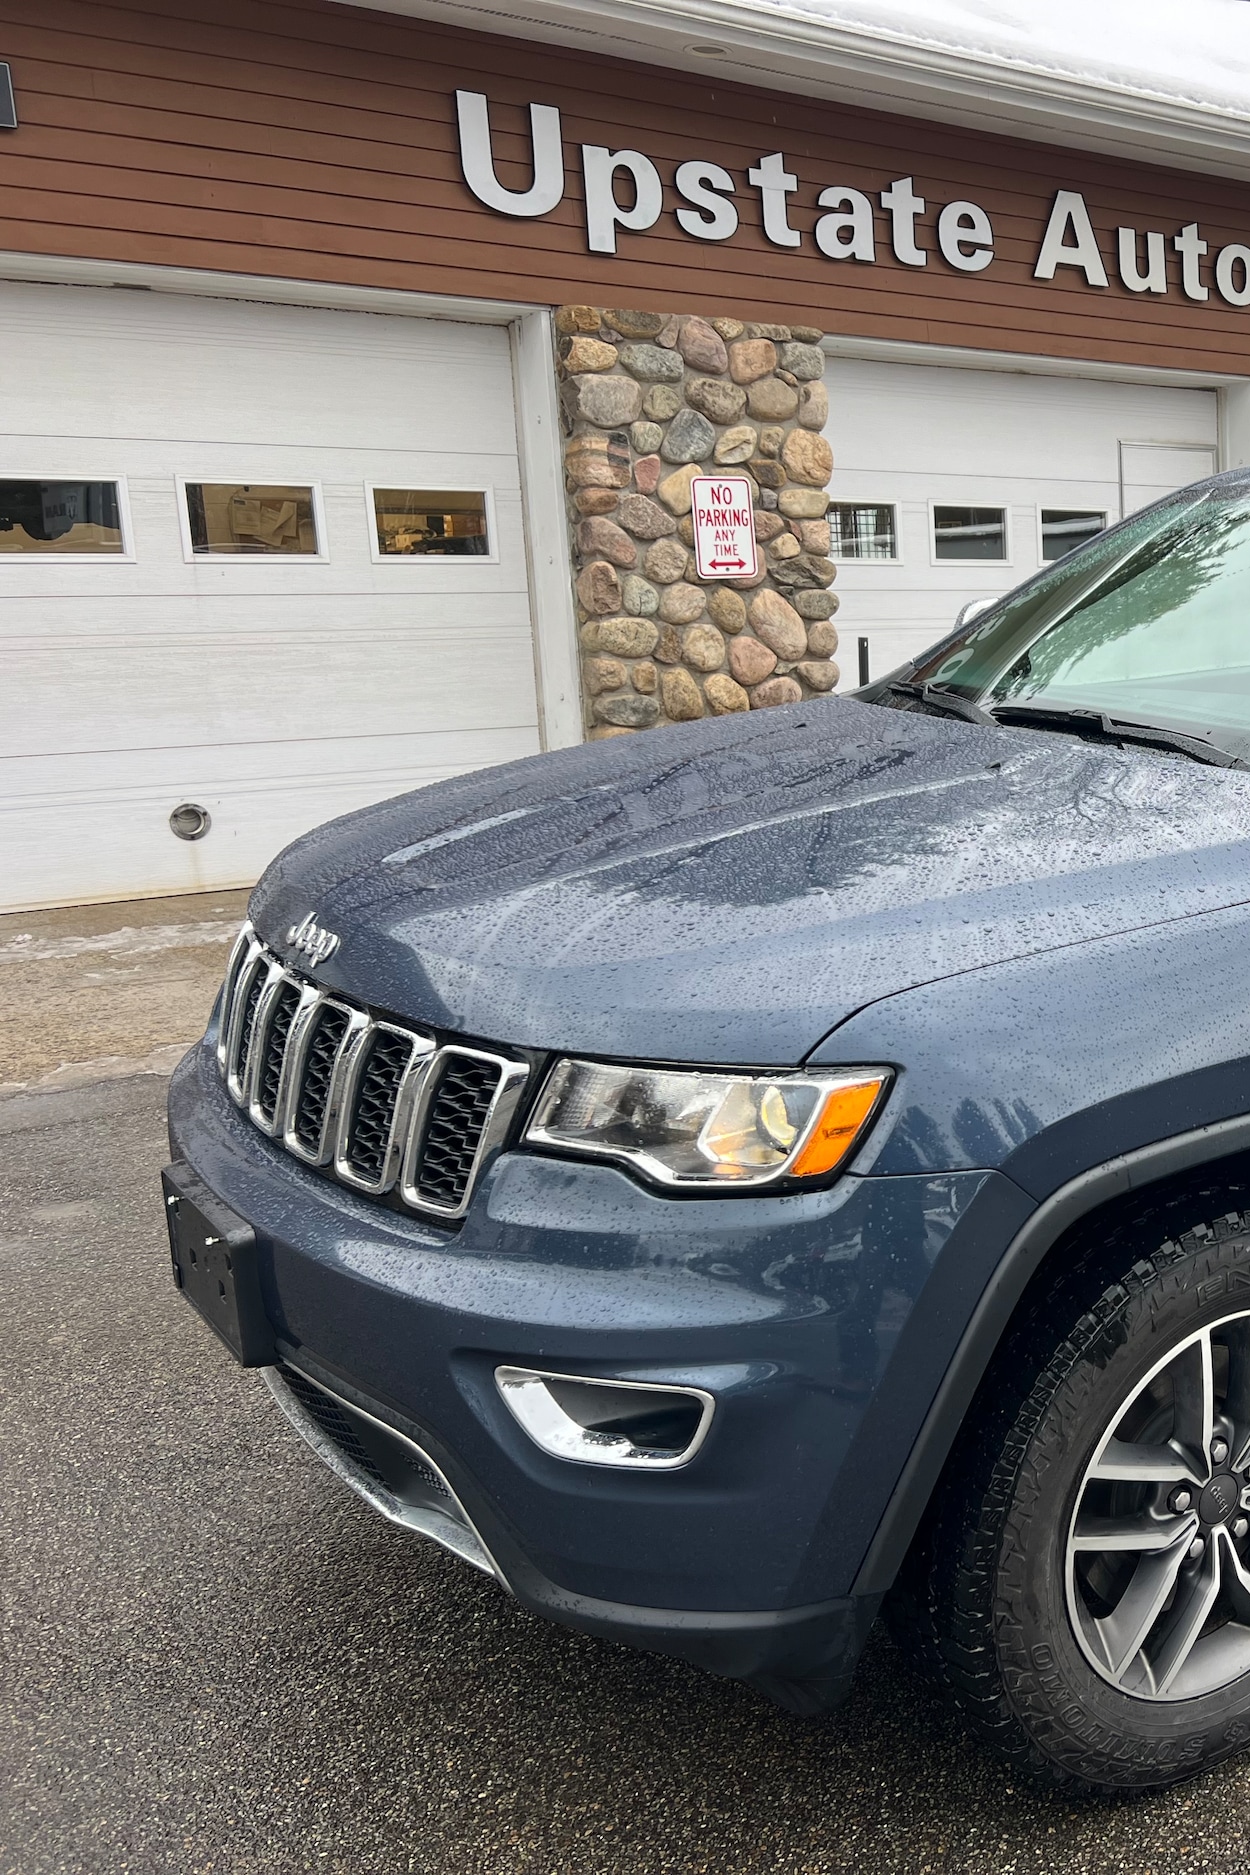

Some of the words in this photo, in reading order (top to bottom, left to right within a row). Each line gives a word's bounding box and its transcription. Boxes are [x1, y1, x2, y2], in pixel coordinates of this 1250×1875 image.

[455, 89, 995, 273] Upstate
[710, 486, 732, 505] NO
[698, 509, 749, 527] PARKING
[714, 529, 736, 542] ANY
[713, 544, 739, 556] TIME
[286, 910, 341, 969] Jeep
[1030, 1642, 1210, 1763] SUMITOMO
